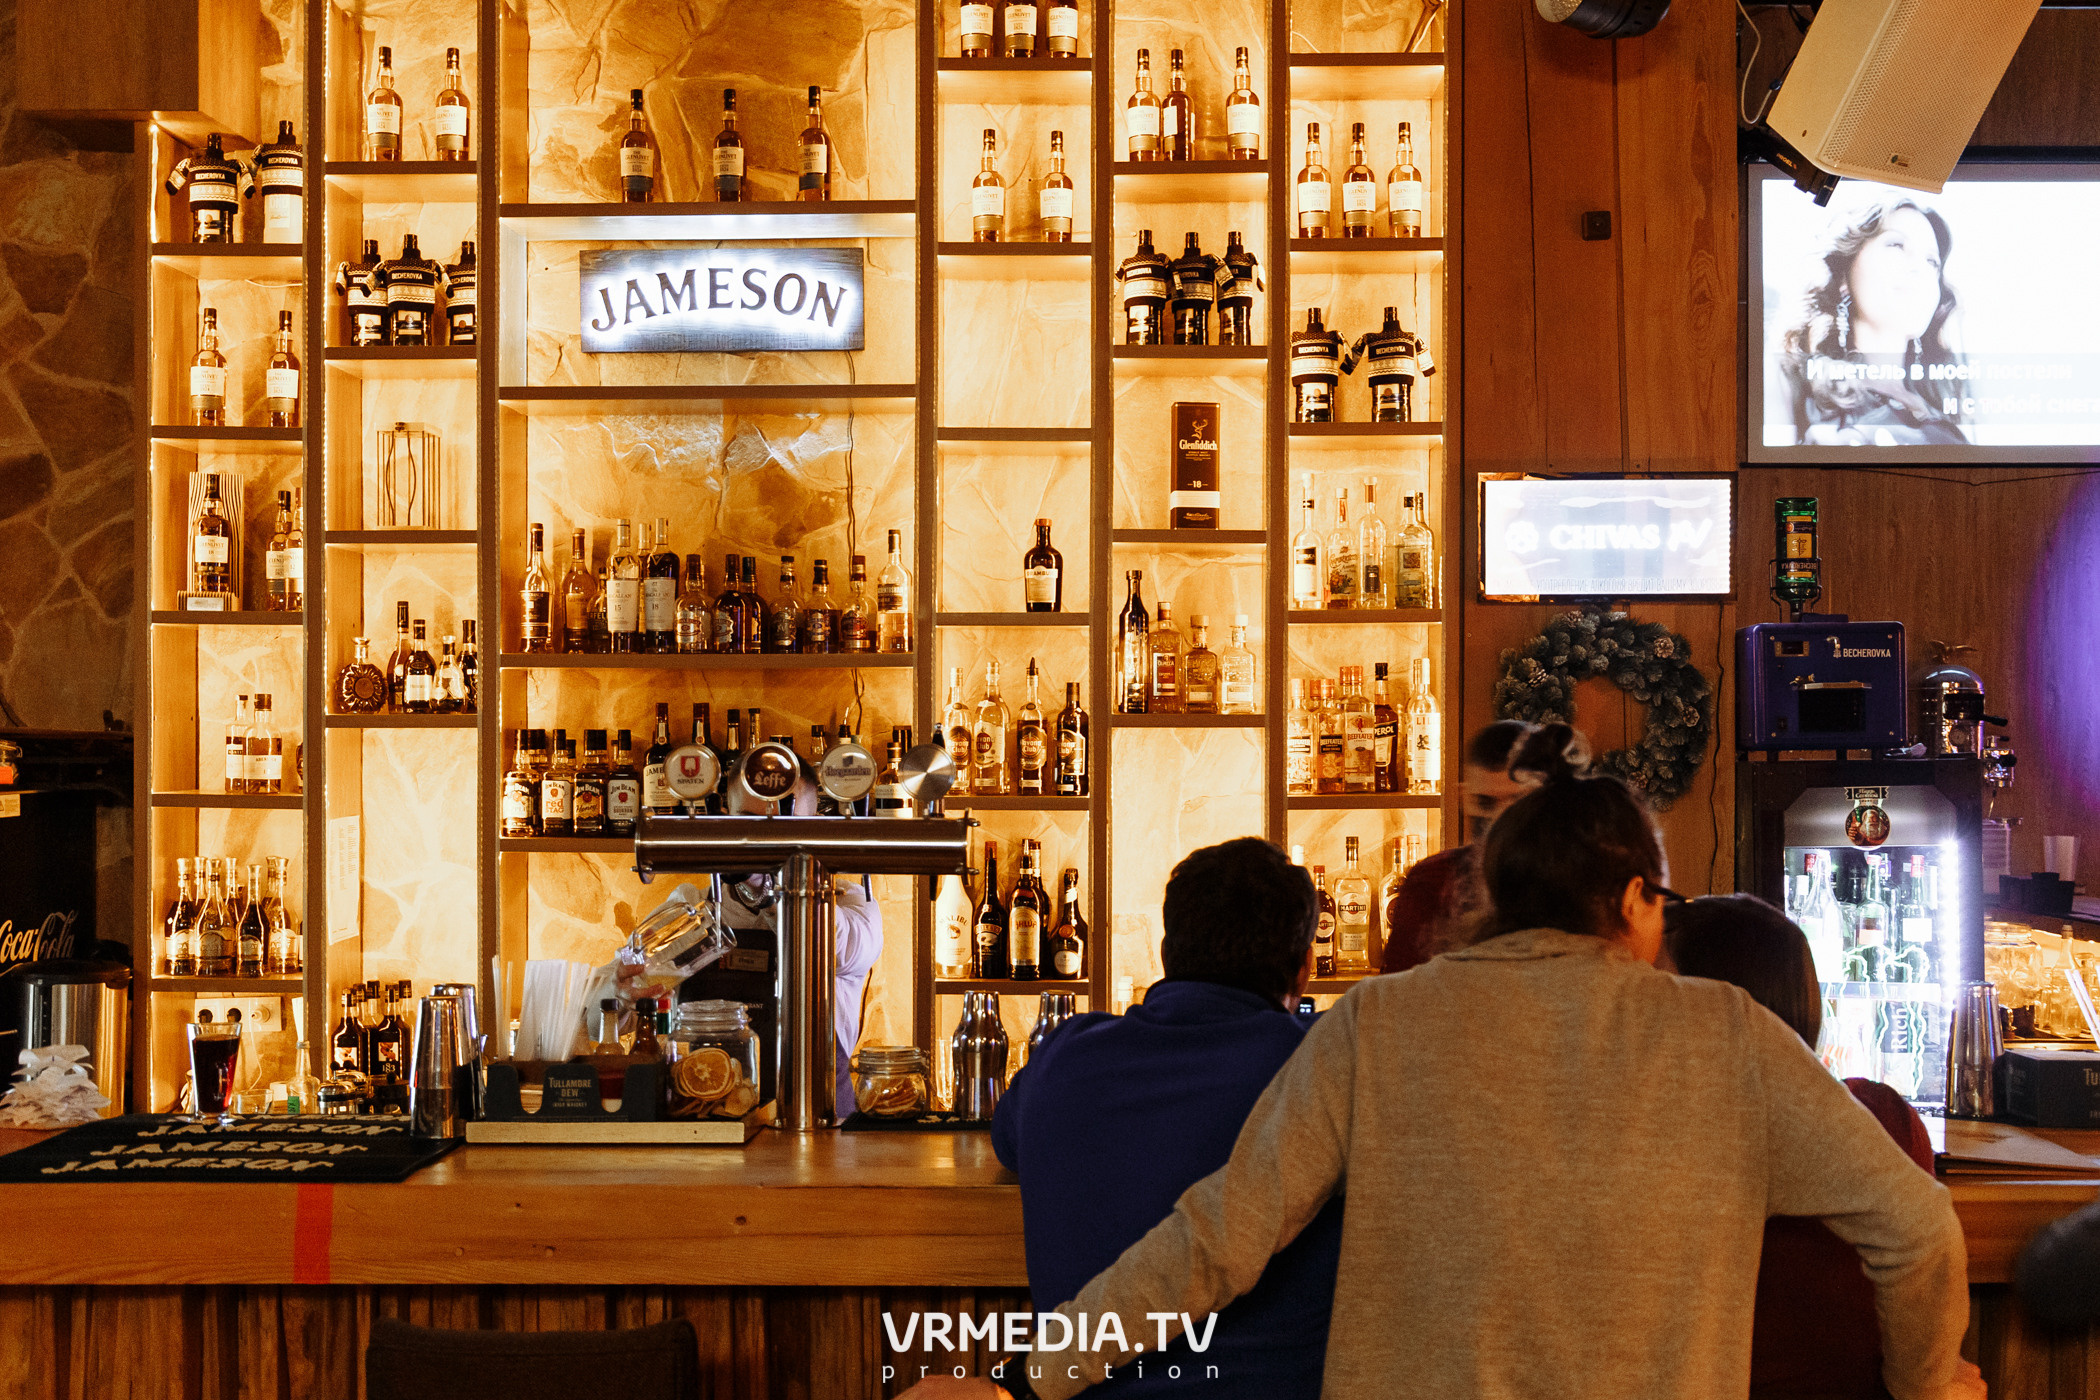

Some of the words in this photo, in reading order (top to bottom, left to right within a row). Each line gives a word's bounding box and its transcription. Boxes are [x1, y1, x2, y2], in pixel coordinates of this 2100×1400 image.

[268, 157, 299, 165] BECHEROVKA
[392, 272, 423, 280] BECHEROVKA
[591, 267, 848, 332] JAMESON
[1807, 359, 1823, 380] И
[1828, 363, 1906, 380] метель
[1910, 364, 1924, 380] в
[1928, 359, 1981, 380] моей
[1943, 397, 1957, 414] и
[1962, 397, 1975, 414] с
[1980, 393, 2041, 414] тобой
[1179, 439, 1218, 450] Glenfiddich
[1192, 480, 1202, 488] 18
[1549, 524, 1661, 550] CHIVAS
[1843, 648, 1892, 658] BECHEROVKA
[1416, 716, 1431, 725] LIL
[1347, 733, 1374, 741] BEEFEATER
[1023, 745, 1037, 753] Club
[646, 766, 665, 776] JAME
[824, 765, 871, 778] Hoegaarden
[753, 771, 787, 789] Leffe
[584, 783, 601, 794] BEAM
[610, 785, 622, 795] JIM
[620, 783, 636, 794] BEAM
[546, 799, 564, 808] red
[0, 909, 79, 962] Coca-Cola
[1890, 1007, 1909, 1051] Rich
[548, 1077, 592, 1088] TULLAMORE
[561, 1088, 579, 1097] DEW
[137, 1122, 404, 1138] JAMESON
[89, 1140, 369, 1157] JAMESON
[40, 1156, 335, 1175] JAMESON
